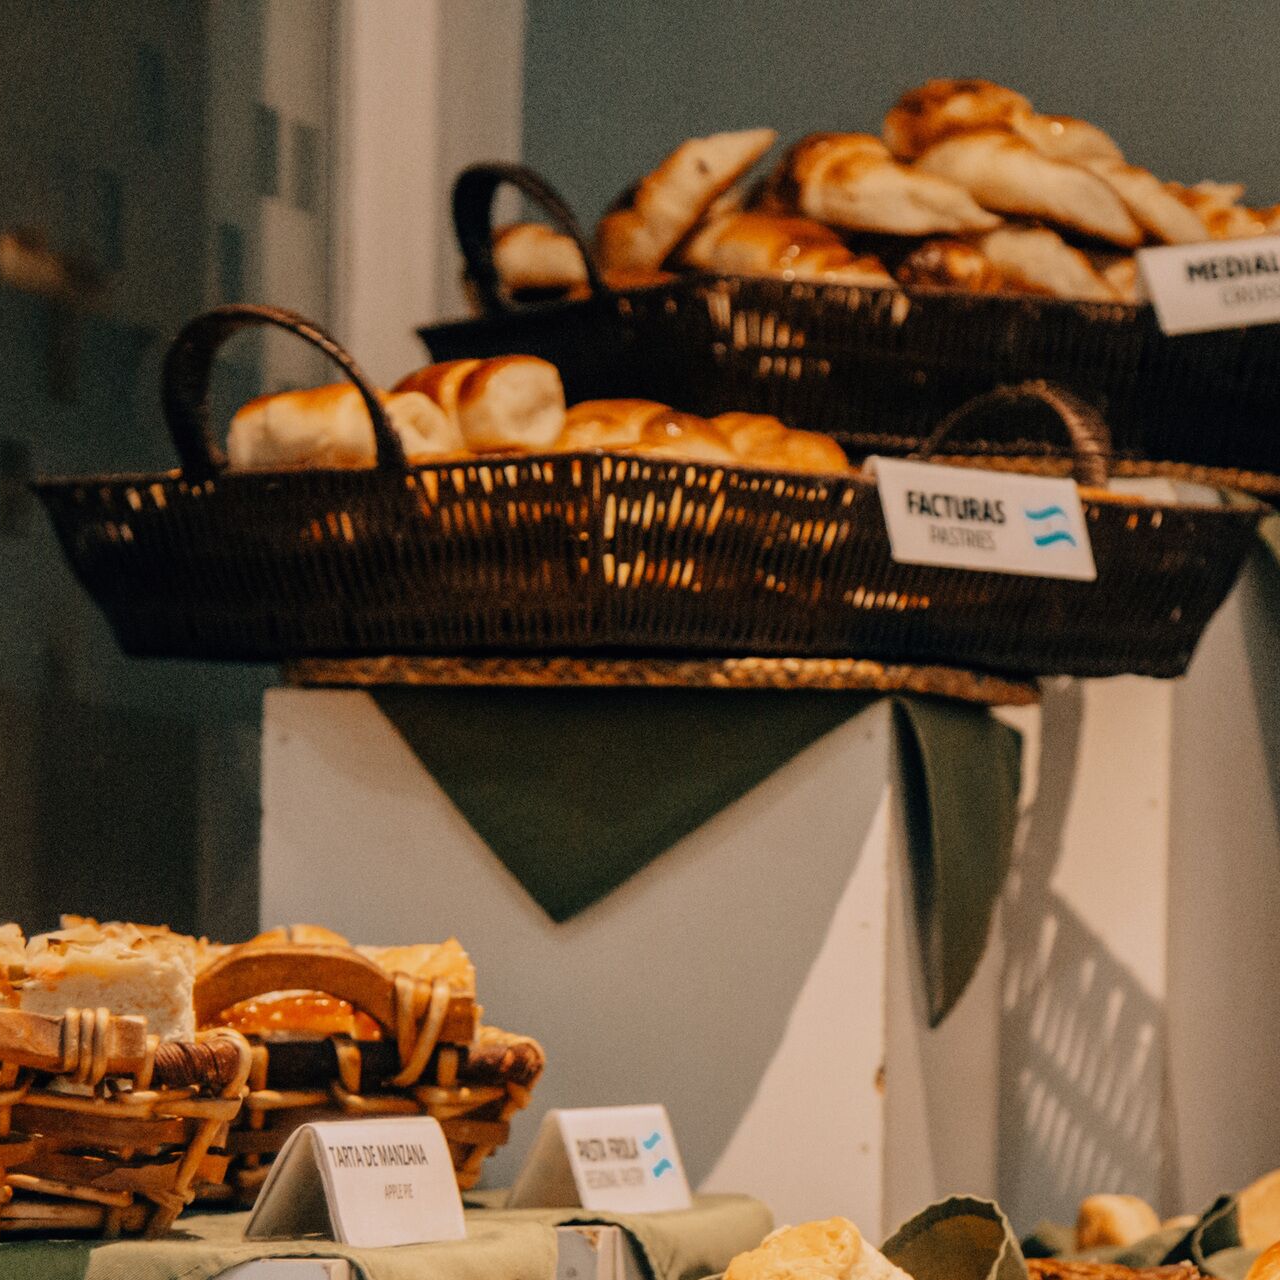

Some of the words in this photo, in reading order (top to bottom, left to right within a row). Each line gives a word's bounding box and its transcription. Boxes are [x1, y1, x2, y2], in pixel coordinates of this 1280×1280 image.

[907, 491, 1006, 524] FACTURAS
[929, 526, 996, 551] PASTRIES
[329, 1145, 364, 1168] TARTA
[364, 1145, 378, 1167] DE
[377, 1144, 429, 1166] MANZANA
